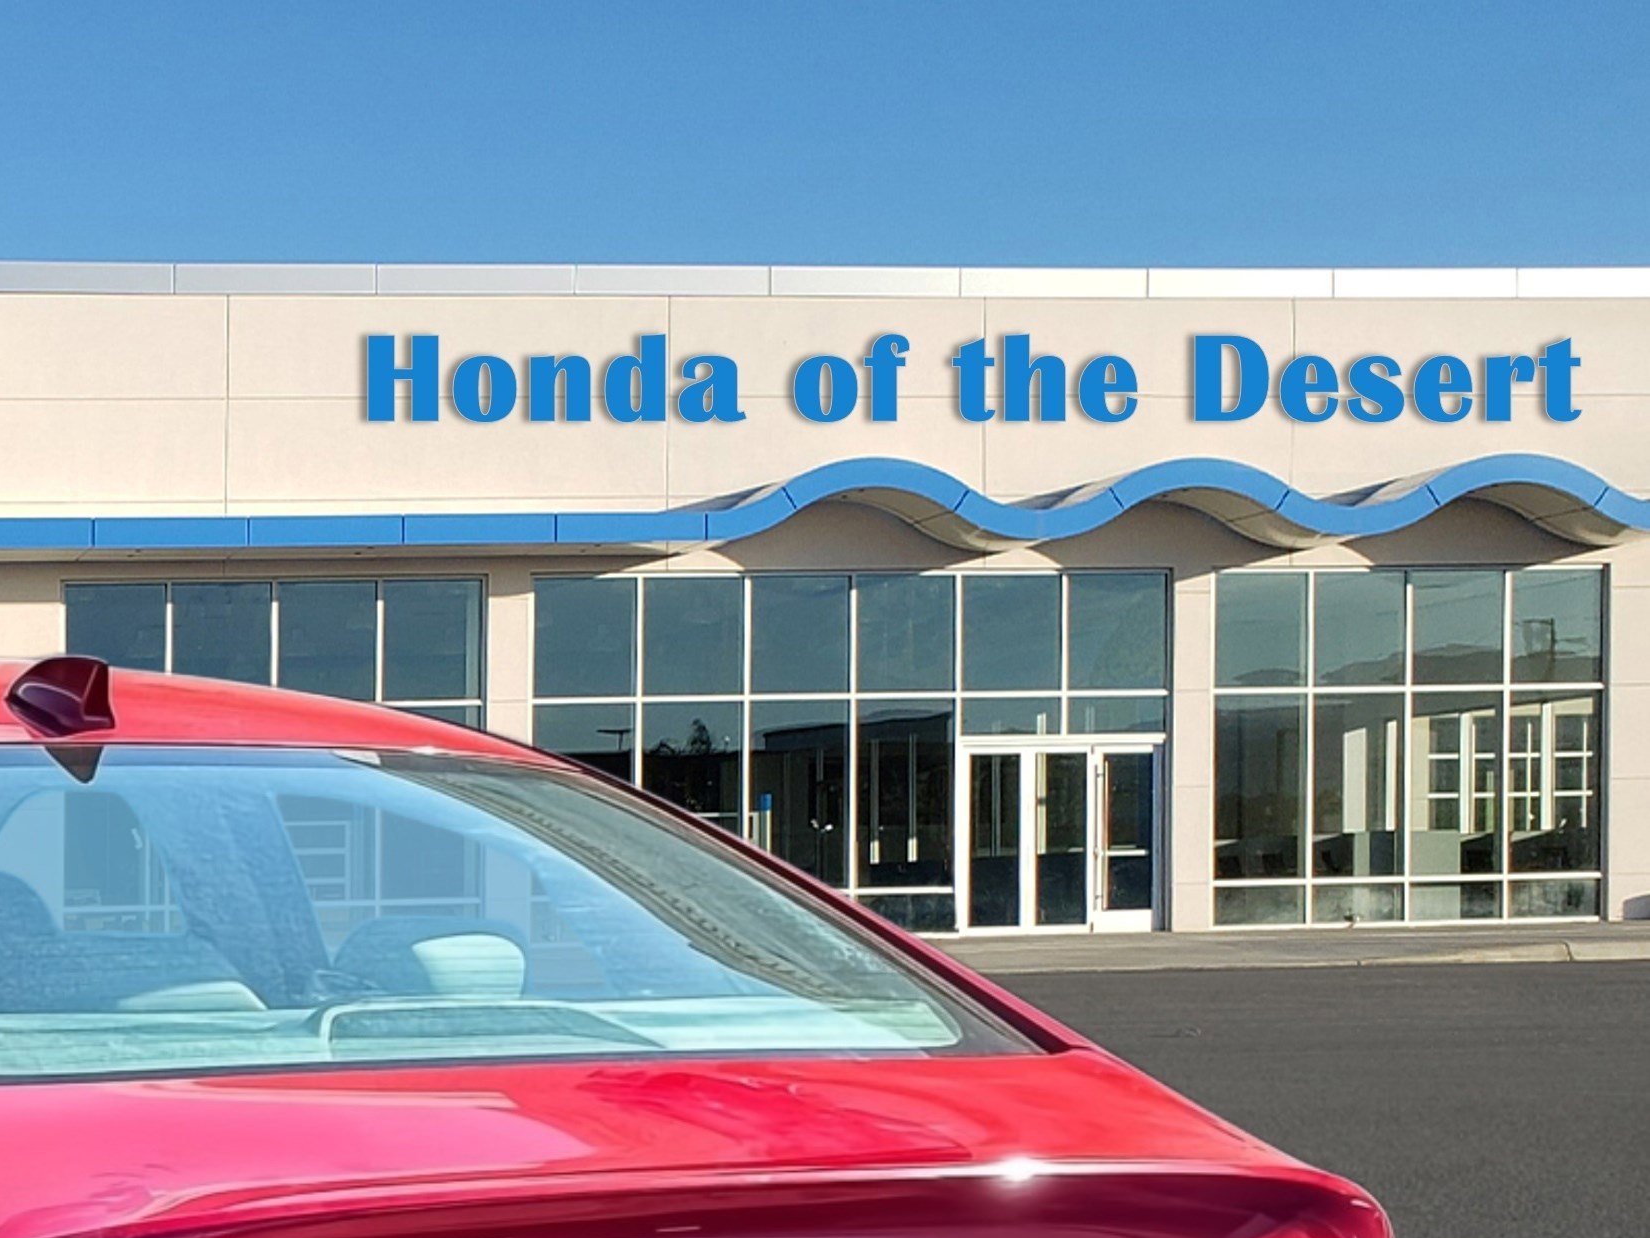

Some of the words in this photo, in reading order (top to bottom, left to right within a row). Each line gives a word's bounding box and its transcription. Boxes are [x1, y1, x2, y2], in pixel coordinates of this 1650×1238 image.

[366, 333, 747, 423] Honda
[793, 333, 910, 423] of
[951, 333, 1138, 423] the
[1194, 335, 1583, 423] Desert
